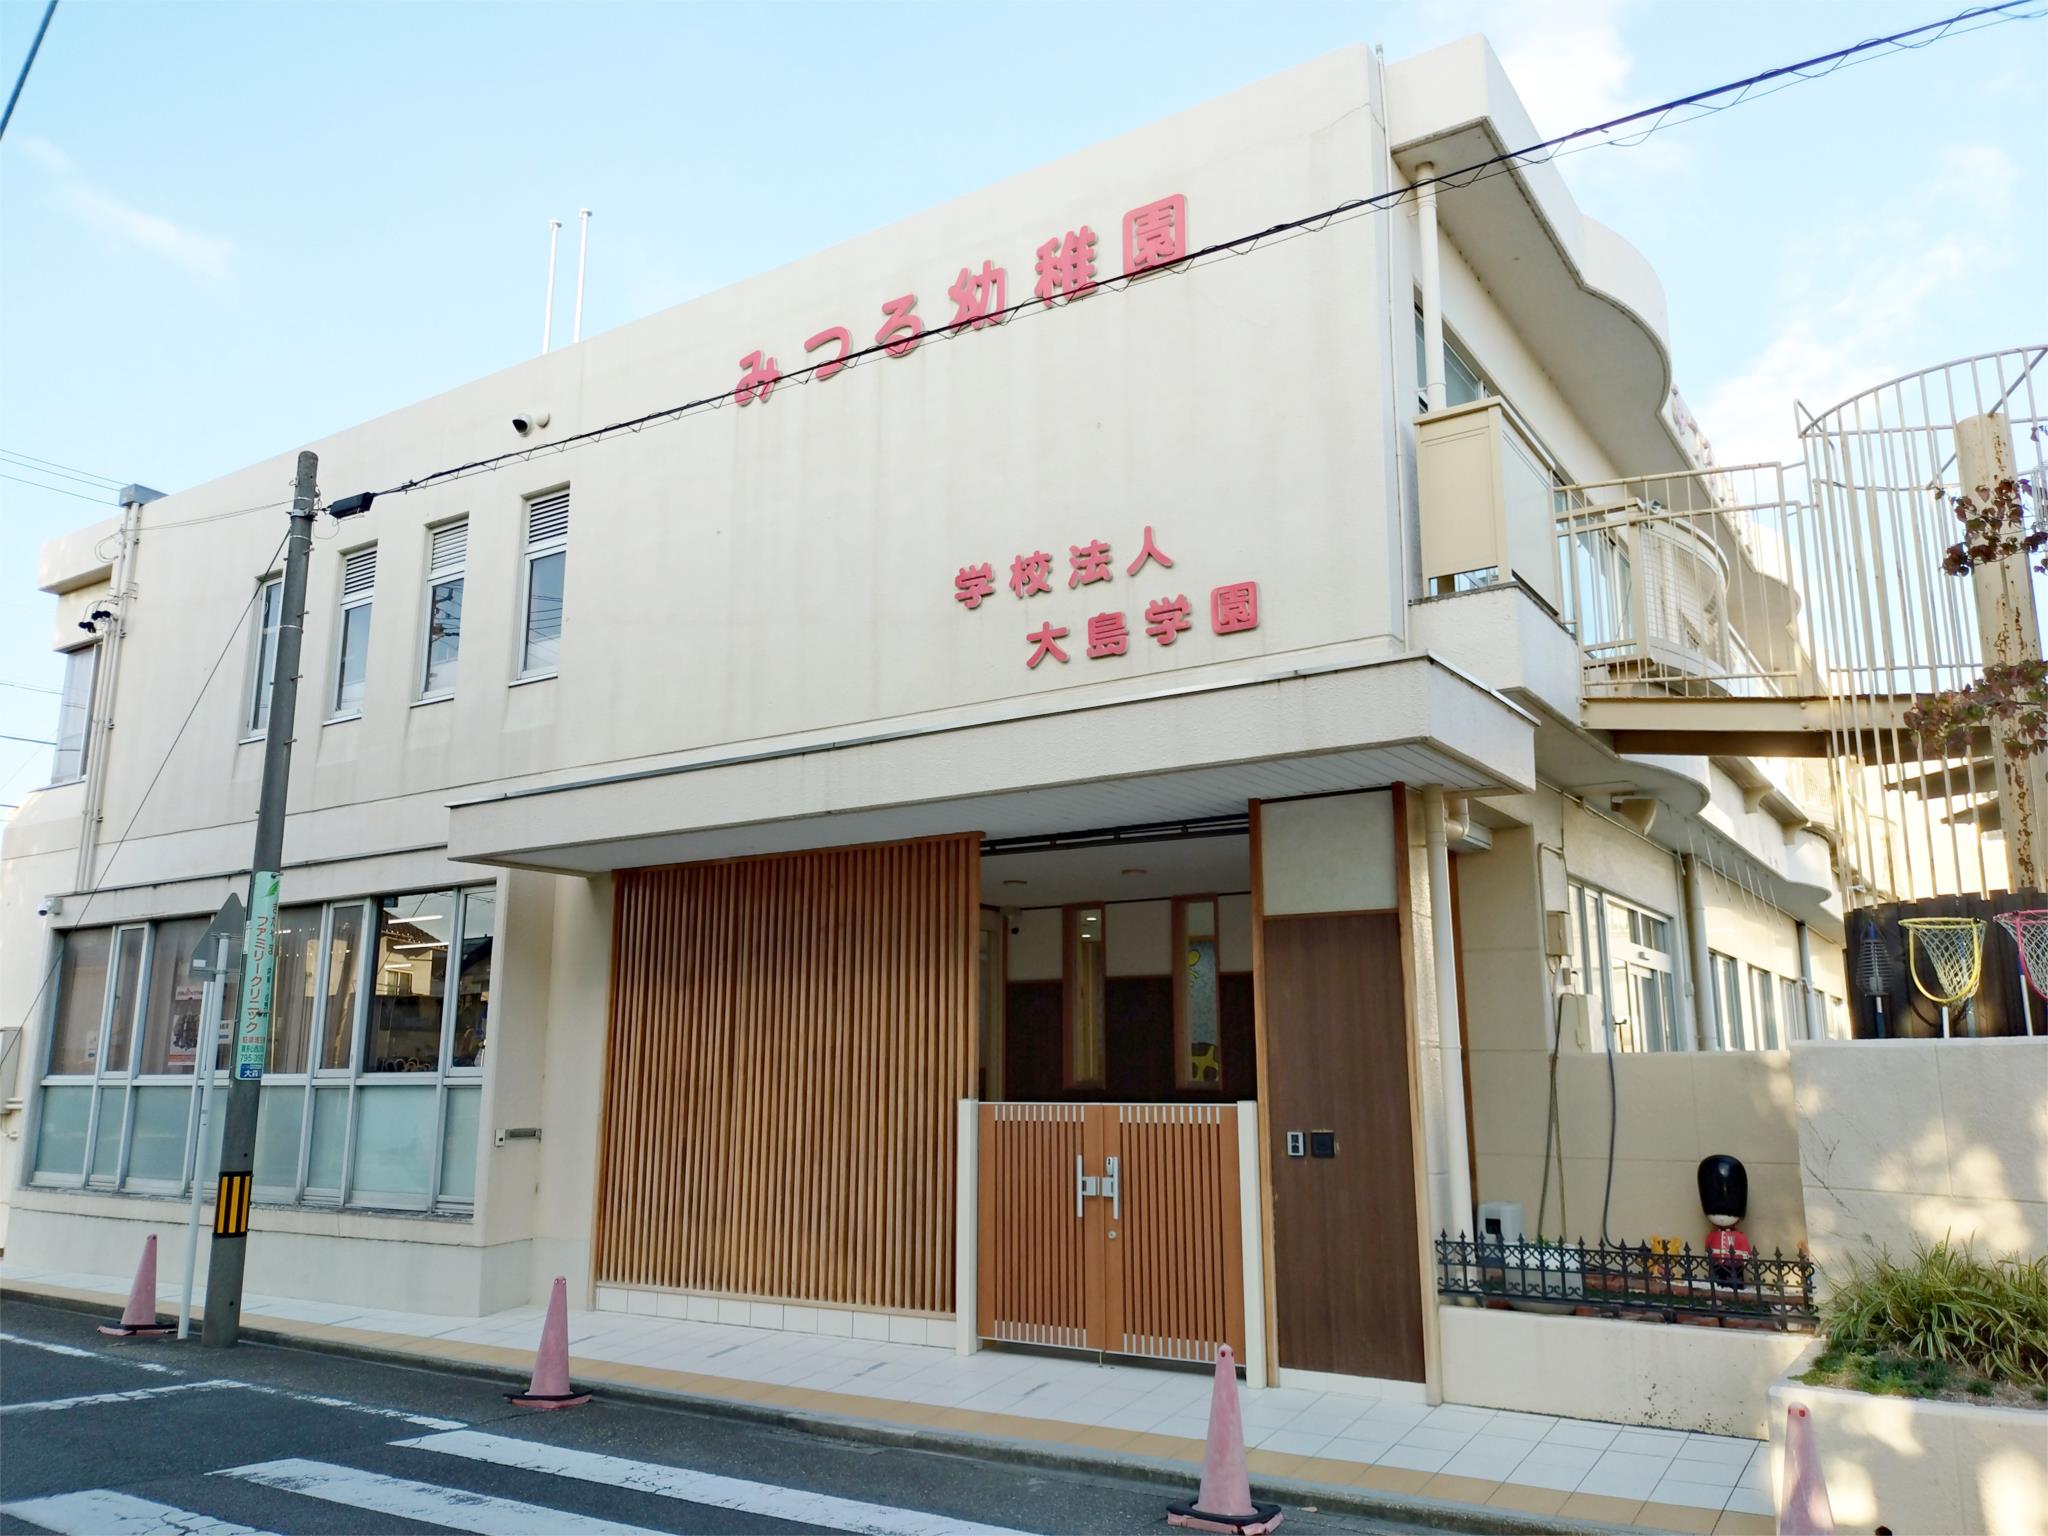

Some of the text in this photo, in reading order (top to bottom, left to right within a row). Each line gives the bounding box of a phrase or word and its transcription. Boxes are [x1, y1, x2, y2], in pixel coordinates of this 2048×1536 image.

[734, 193, 1192, 407] みつる幼稚園
[954, 525, 1174, 609] 学校法人
[1026, 580, 1260, 669] 大島学園
[245, 915, 268, 1034] ファミリークリニック
